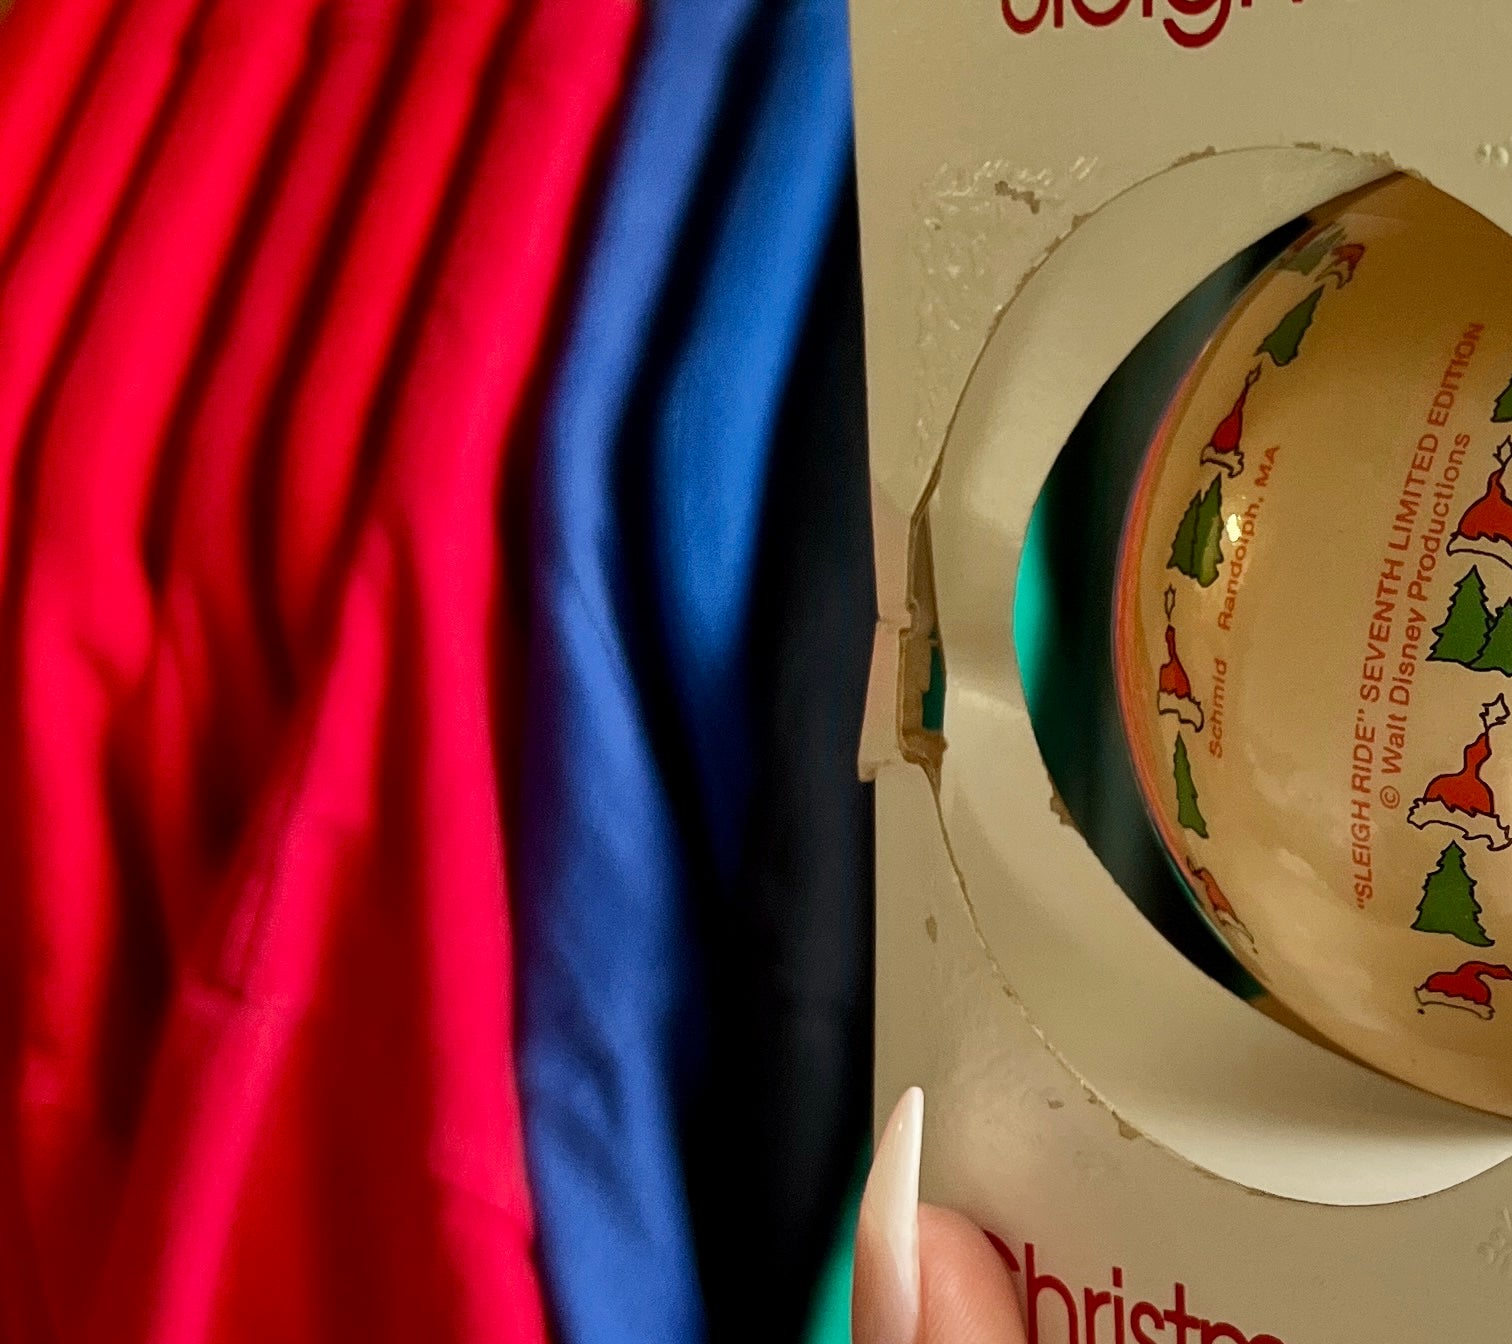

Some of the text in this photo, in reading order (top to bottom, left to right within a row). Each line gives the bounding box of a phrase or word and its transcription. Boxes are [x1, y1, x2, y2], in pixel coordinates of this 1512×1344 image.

[1426, 321, 1485, 428] EDITION
[1387, 432, 1439, 552] LIMITED
[1406, 432, 1471, 602] Productions
[1209, 657, 1228, 759] Schmid
[1254, 444, 1280, 489] MA
[1359, 557, 1405, 703] SEVENTH
[1388, 607, 1428, 707] Disney
[1380, 712, 1408, 776] Walt
[1350, 800, 1374, 910] "SLEIGH
